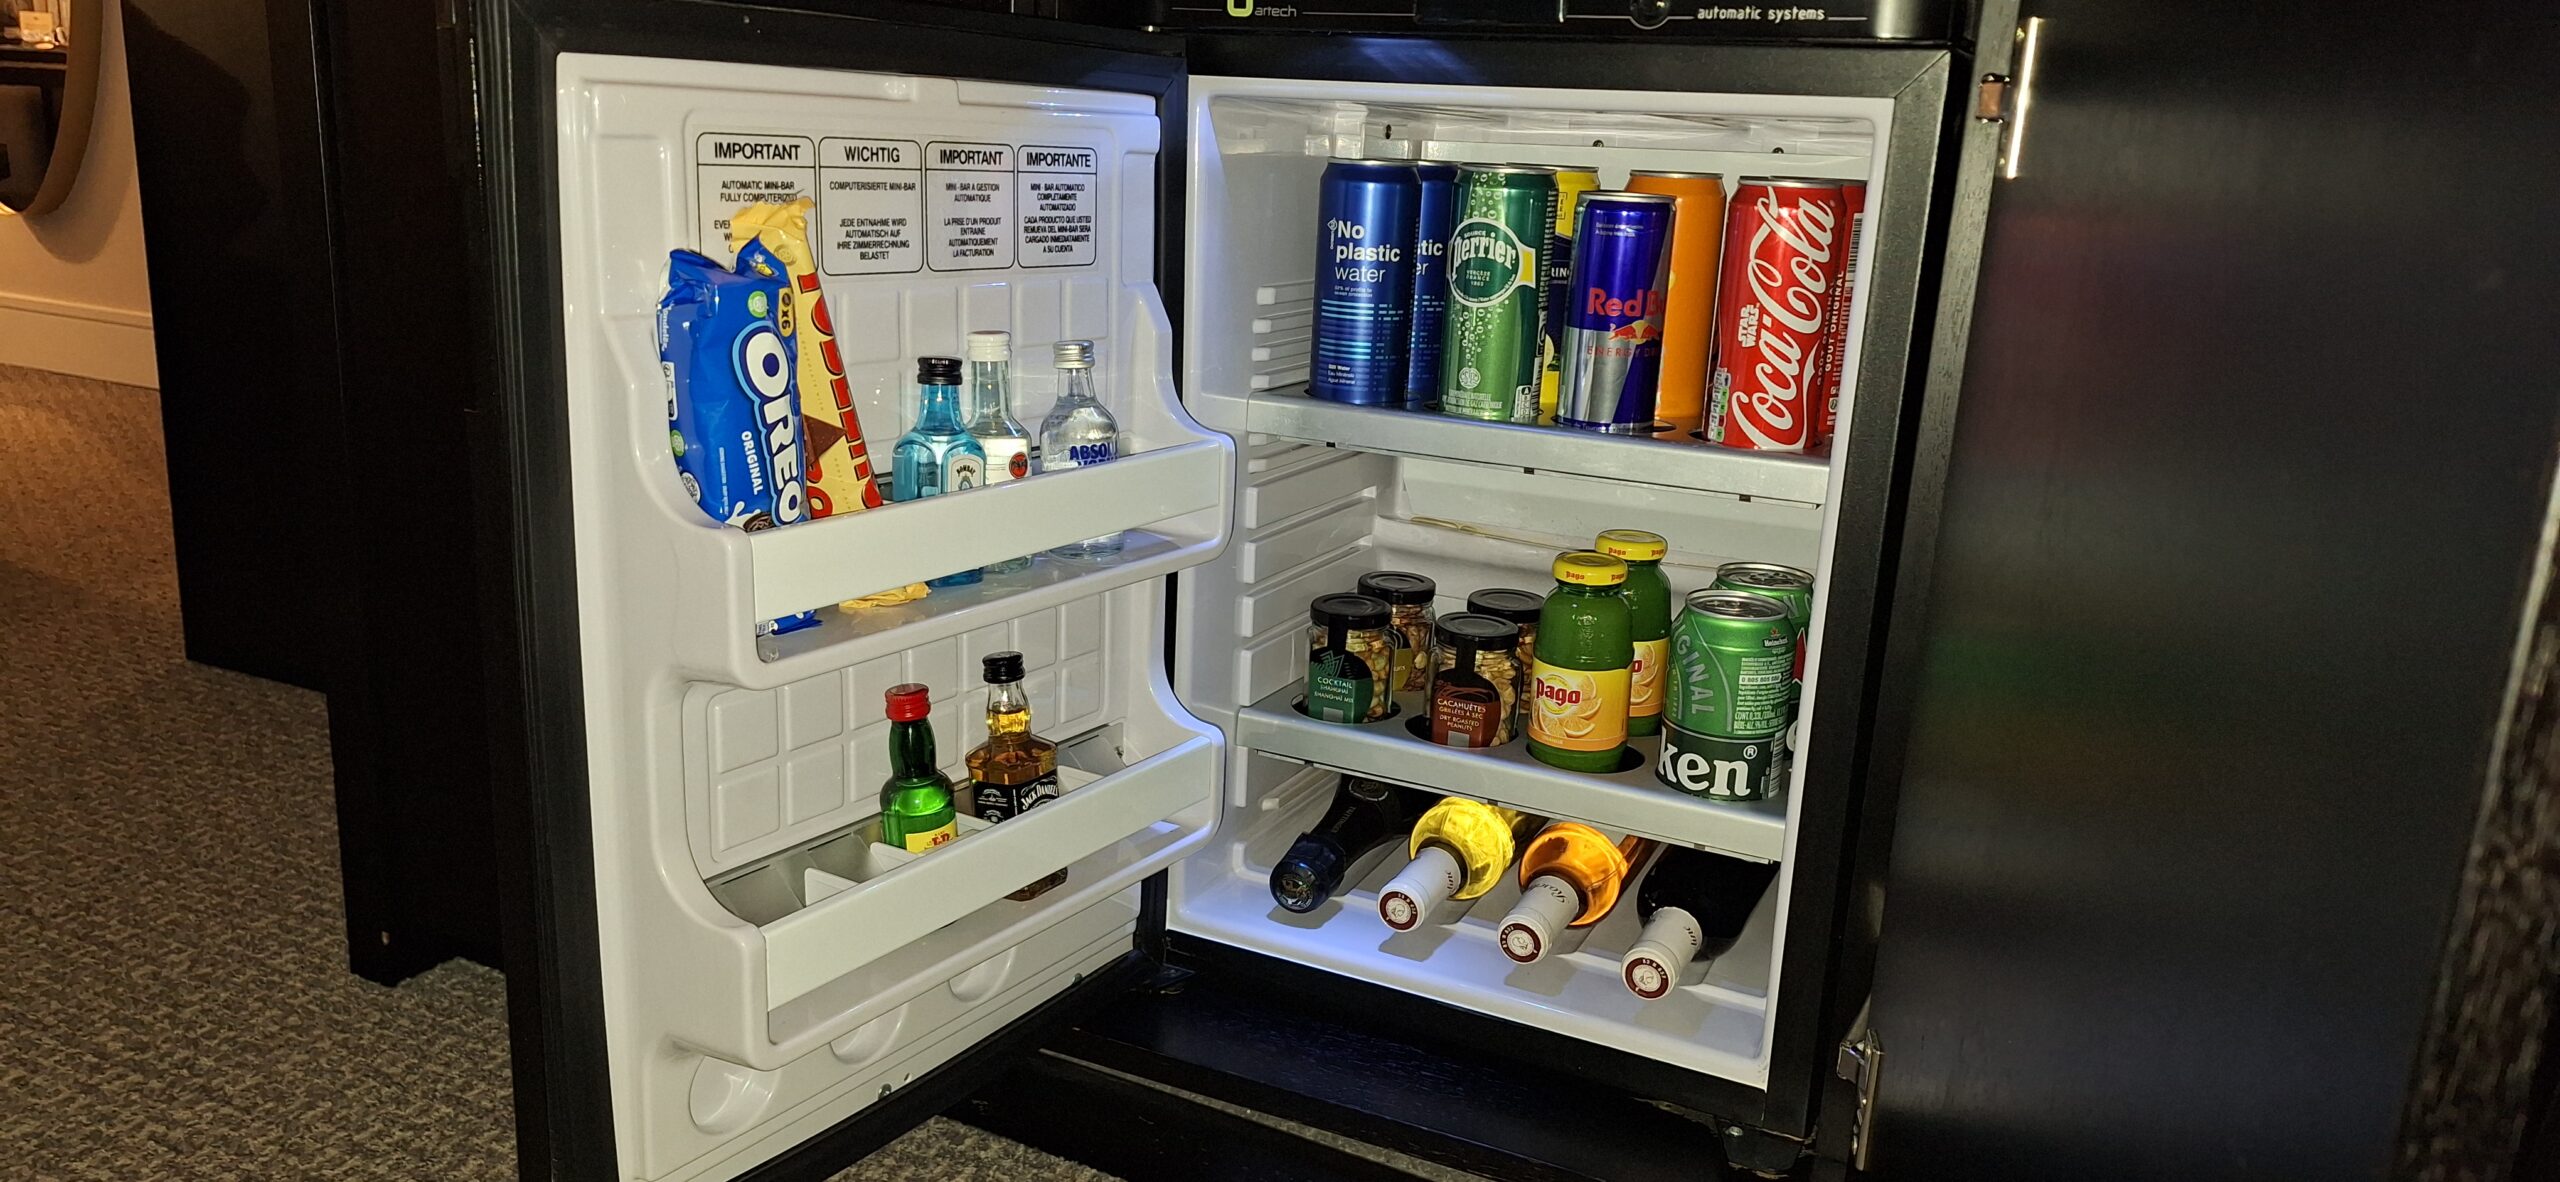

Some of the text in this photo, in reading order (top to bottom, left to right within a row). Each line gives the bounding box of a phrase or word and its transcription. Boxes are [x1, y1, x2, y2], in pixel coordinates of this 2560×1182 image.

[1697, 5, 1825, 23] automatic systems
[714, 142, 800, 160] IMPORTANT
[844, 146, 900, 162] WICHTIG
[940, 149, 1003, 165] IMPORTANT
[1026, 152, 1091, 167] IMPORTANTE
[721, 181, 794, 190] AUTOMATIC MINI-BAR
[829, 181, 888, 190] COMPUTERISIERTE
[976, 183, 999, 191] GESTION
[720, 193, 742, 202] FULLY
[954, 194, 991, 202] AUTOMATIQUE
[1037, 193, 1077, 201] COMPLETAMENTE
[857, 218, 890, 227] ENTNAHME
[979, 217, 1001, 225] PRODUIT
[845, 229, 889, 238] AUTOMATISCH
[1337, 220, 1365, 239] No
[949, 238, 998, 246] AUTOMATIQUEMENT
[1025, 235, 1049, 243] CARGADO
[853, 240, 910, 249] ZIMMERRECHNUNG
[1055, 245, 1073, 253] CUENTA
[860, 251, 890, 260] BELASTET
[960, 248, 994, 257] FACTURATION
[1336, 242, 1401, 263] plastic
[1335, 265, 1386, 283] water
[1587, 287, 1643, 317] Red
[1829, 270, 1844, 332] ORIGINAL
[1731, 185, 1835, 450] Coca-Cola
[745, 331, 801, 524] OREO
[741, 430, 764, 496] ORIGINAL
[1317, 676, 1353, 689] COCKTAIL
[1447, 721, 1473, 731] PEANUTS
[1453, 716, 1480, 727] ROASTED
